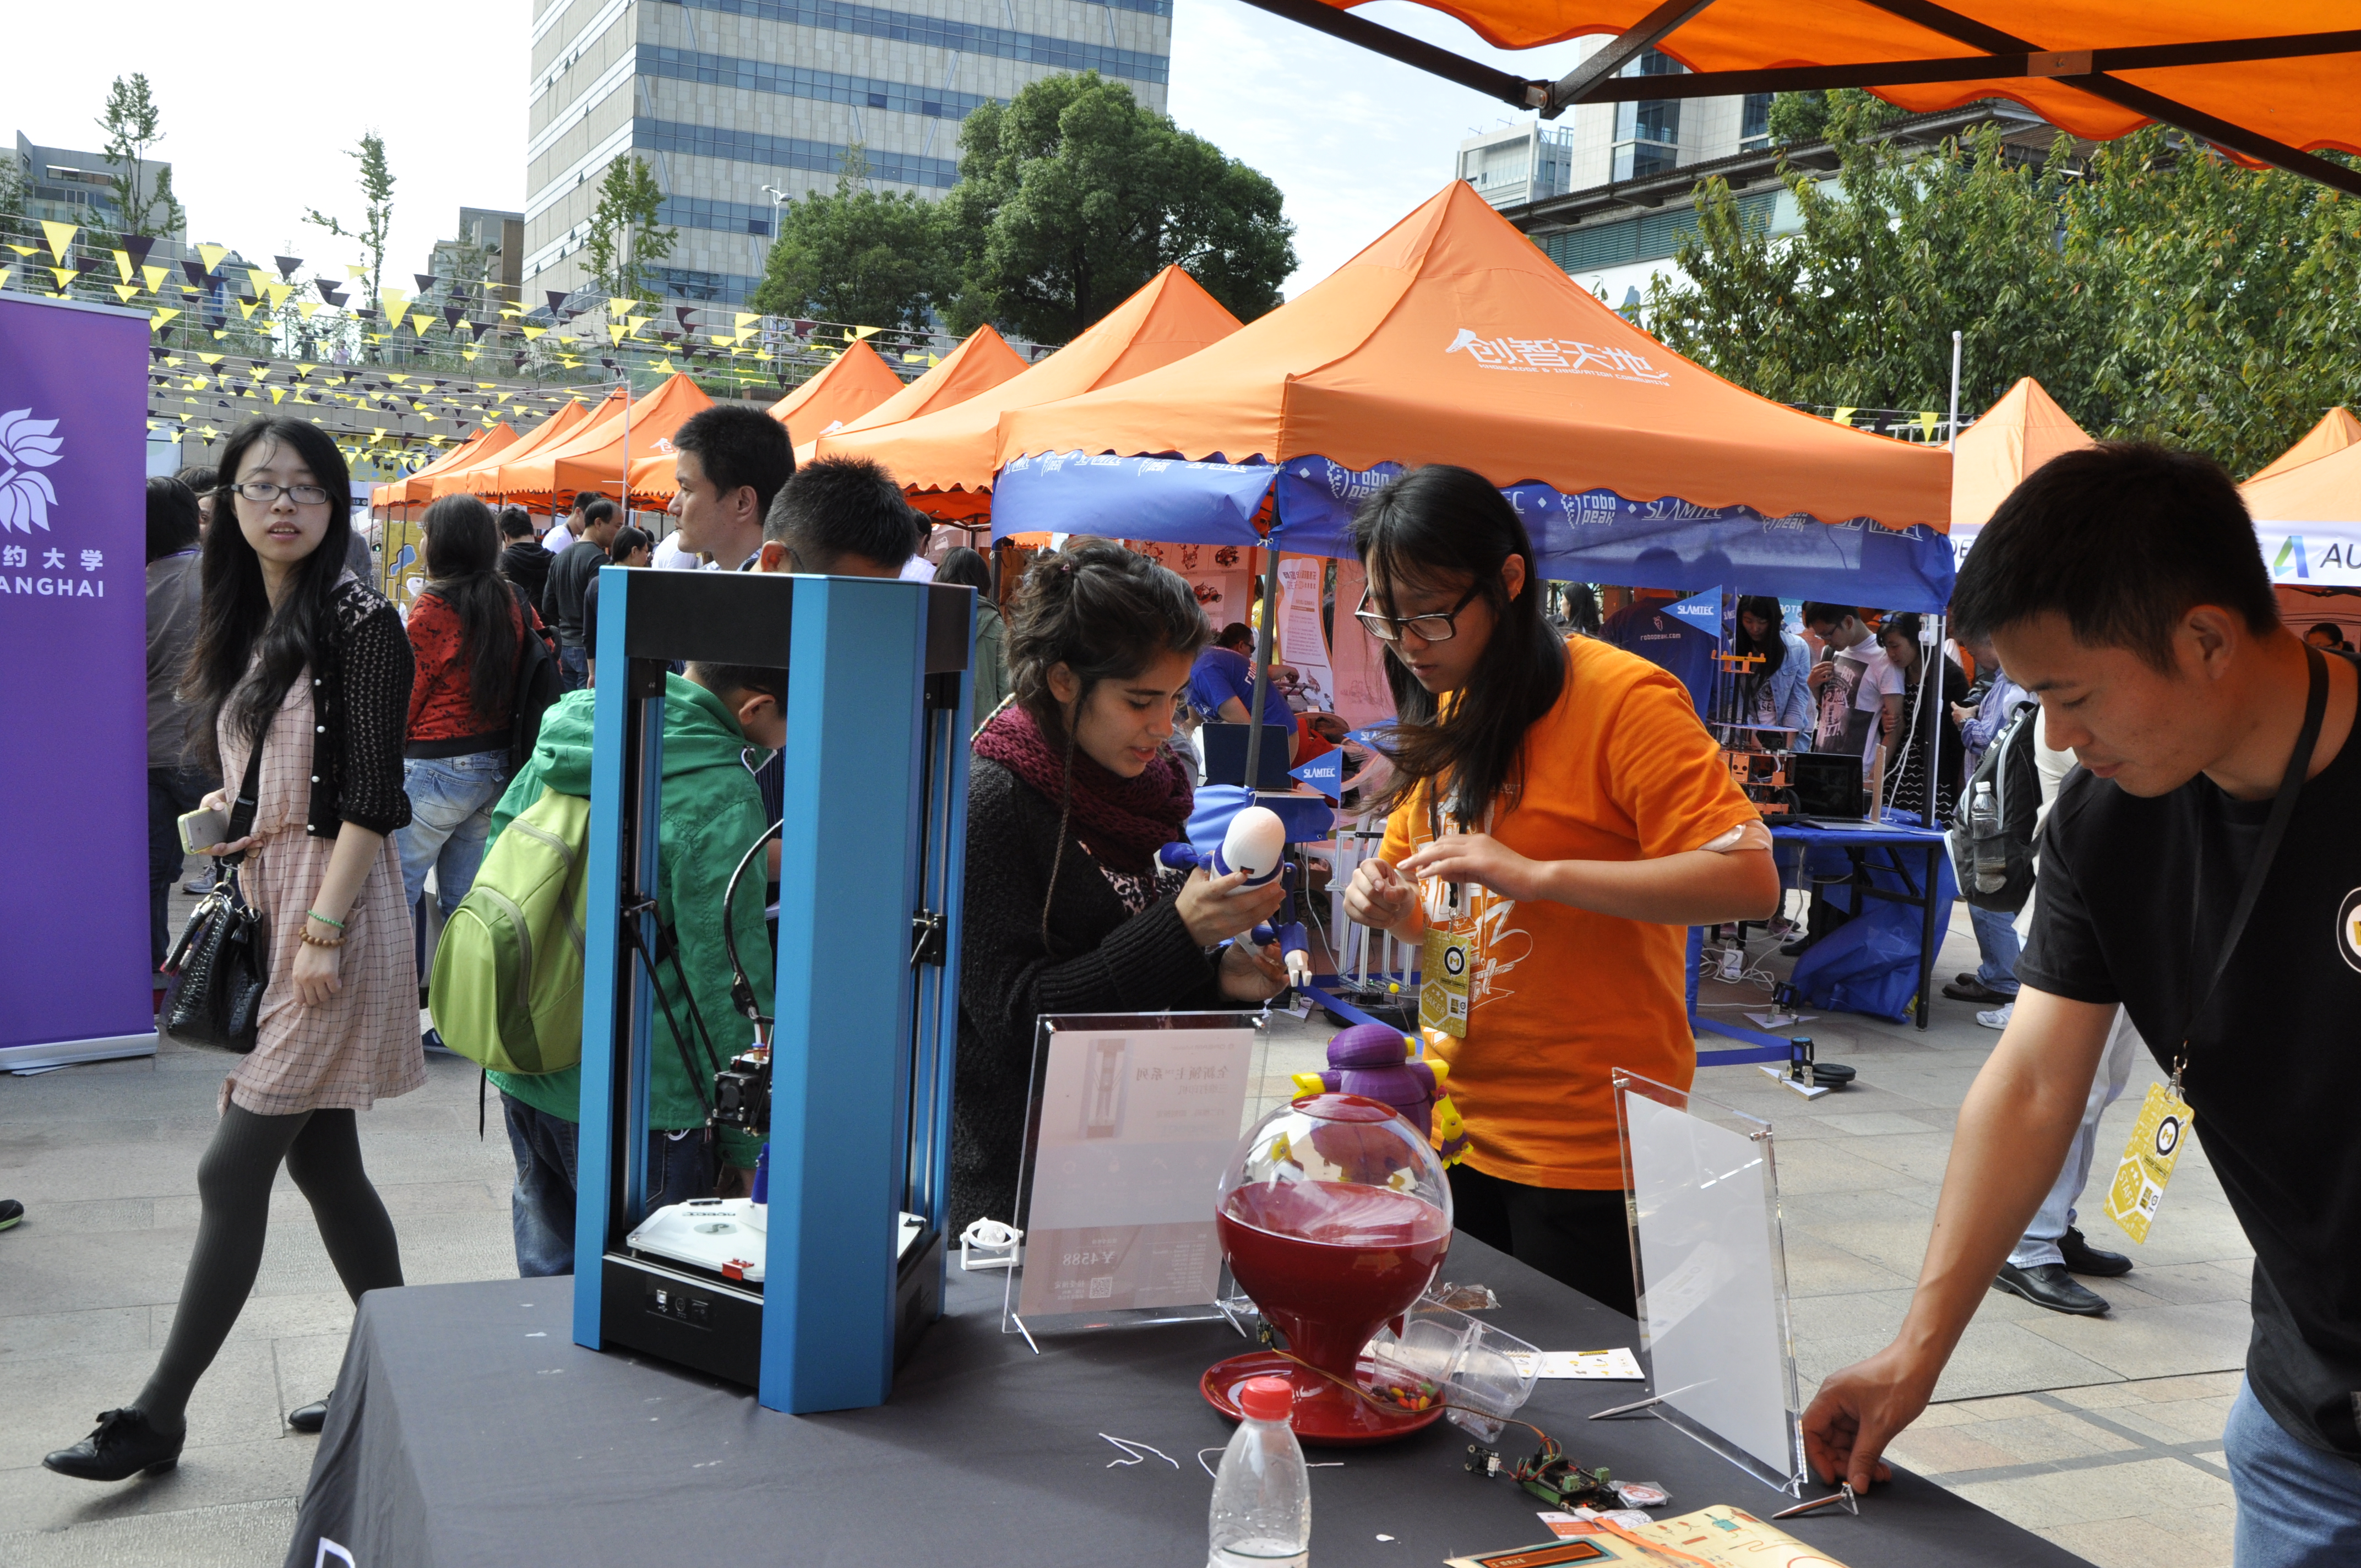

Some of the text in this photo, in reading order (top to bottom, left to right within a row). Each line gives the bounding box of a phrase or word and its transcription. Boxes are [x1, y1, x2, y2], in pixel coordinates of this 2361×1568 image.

[1461, 330, 1665, 380] 创智天地
[1478, 364, 1539, 373] KNOWLEDGE
[1554, 368, 1613, 378] INNOVATION
[1615, 374, 1671, 387] COMMUNITY
[1583, 494, 1616, 510] robo
[1581, 510, 1615, 526] peak
[3, 545, 104, 571] 约大学
[2319, 543, 2361, 570] AU
[0, 575, 104, 597] ANGHAI
[1677, 605, 1714, 616] SLAMTEC
[1303, 767, 1335, 778] SLAMTEC
[1423, 992, 1446, 1016] MAKER
[2118, 1170, 2135, 1206] STAFF
[1499, 1558, 1526, 1566] MAKE
